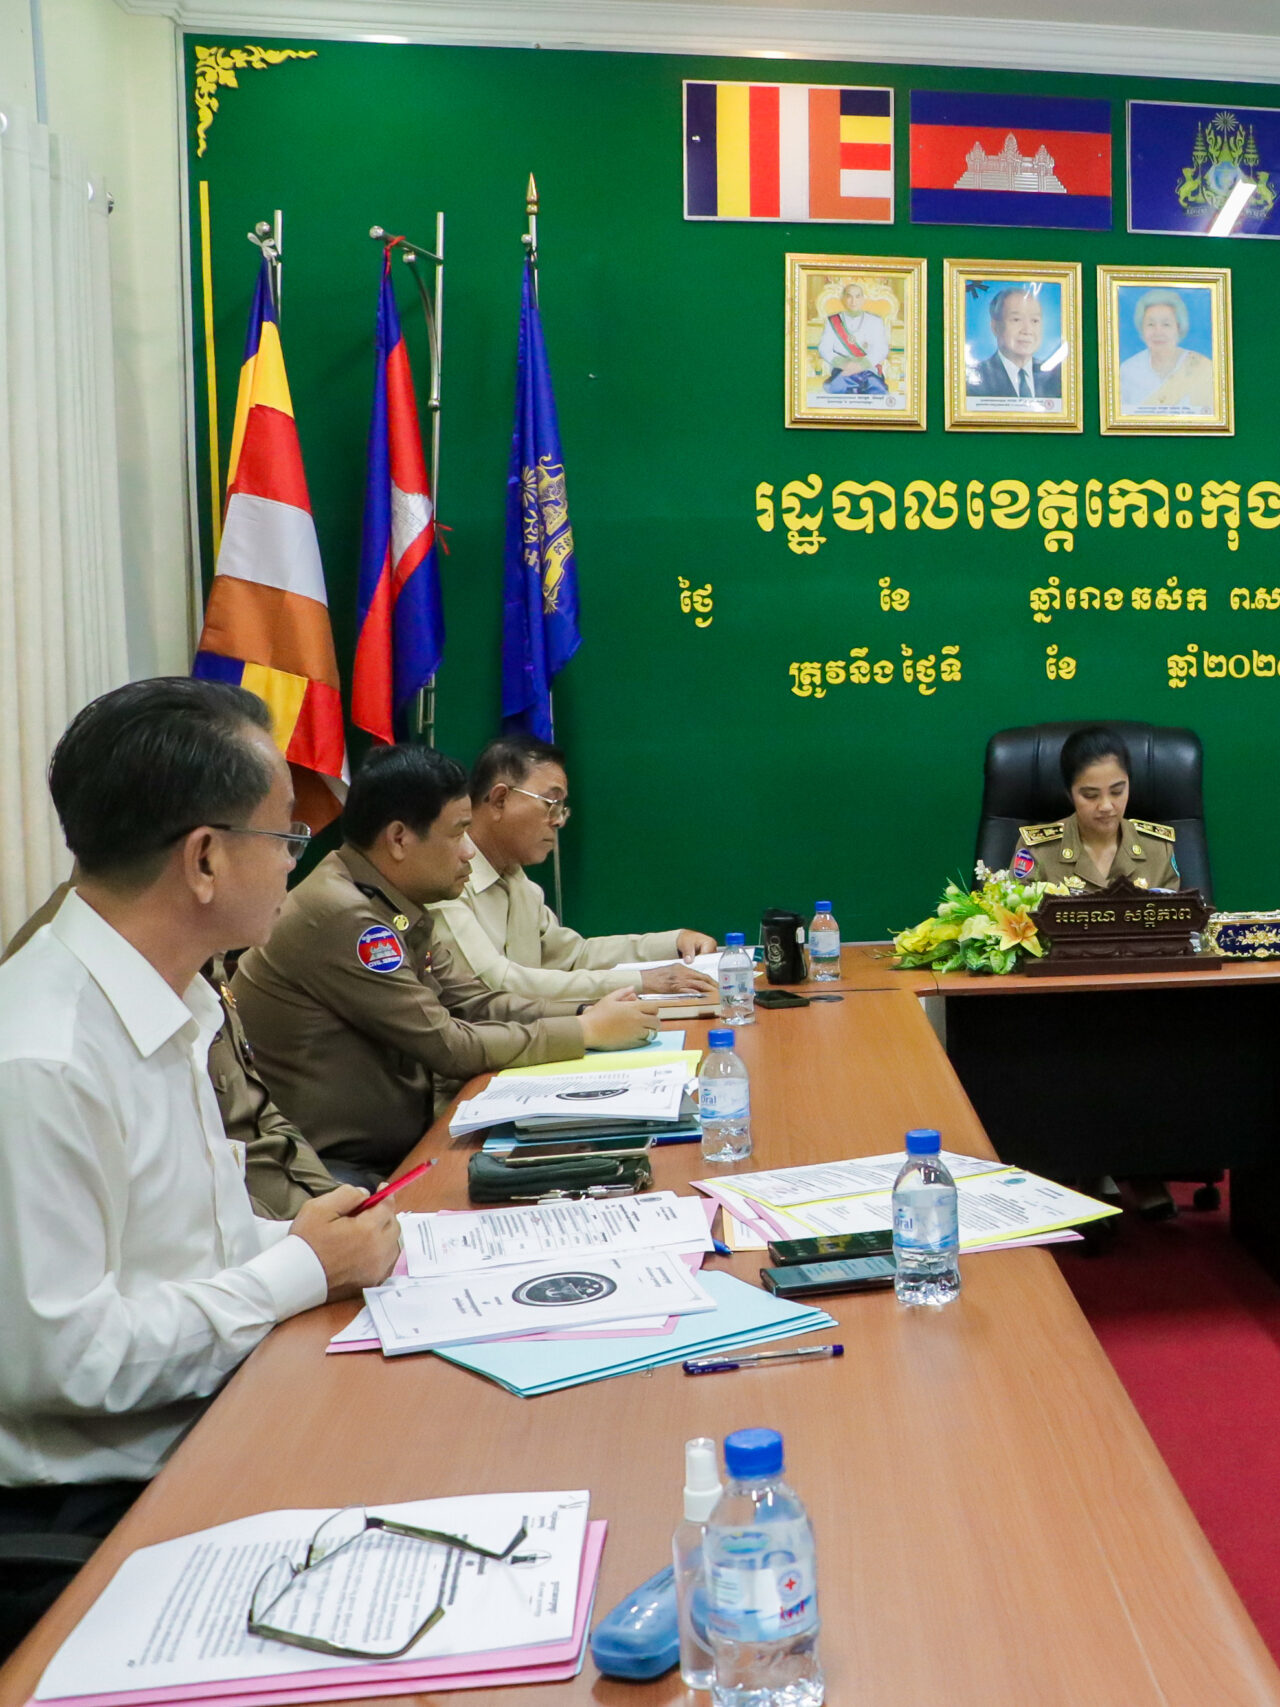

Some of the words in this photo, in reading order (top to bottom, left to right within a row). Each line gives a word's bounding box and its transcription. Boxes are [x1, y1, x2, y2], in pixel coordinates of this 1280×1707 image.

[677, 575, 714, 628] ថ្ងៃ
[878, 576, 911, 612] ខែ
[1045, 643, 1077, 681] ខែ
